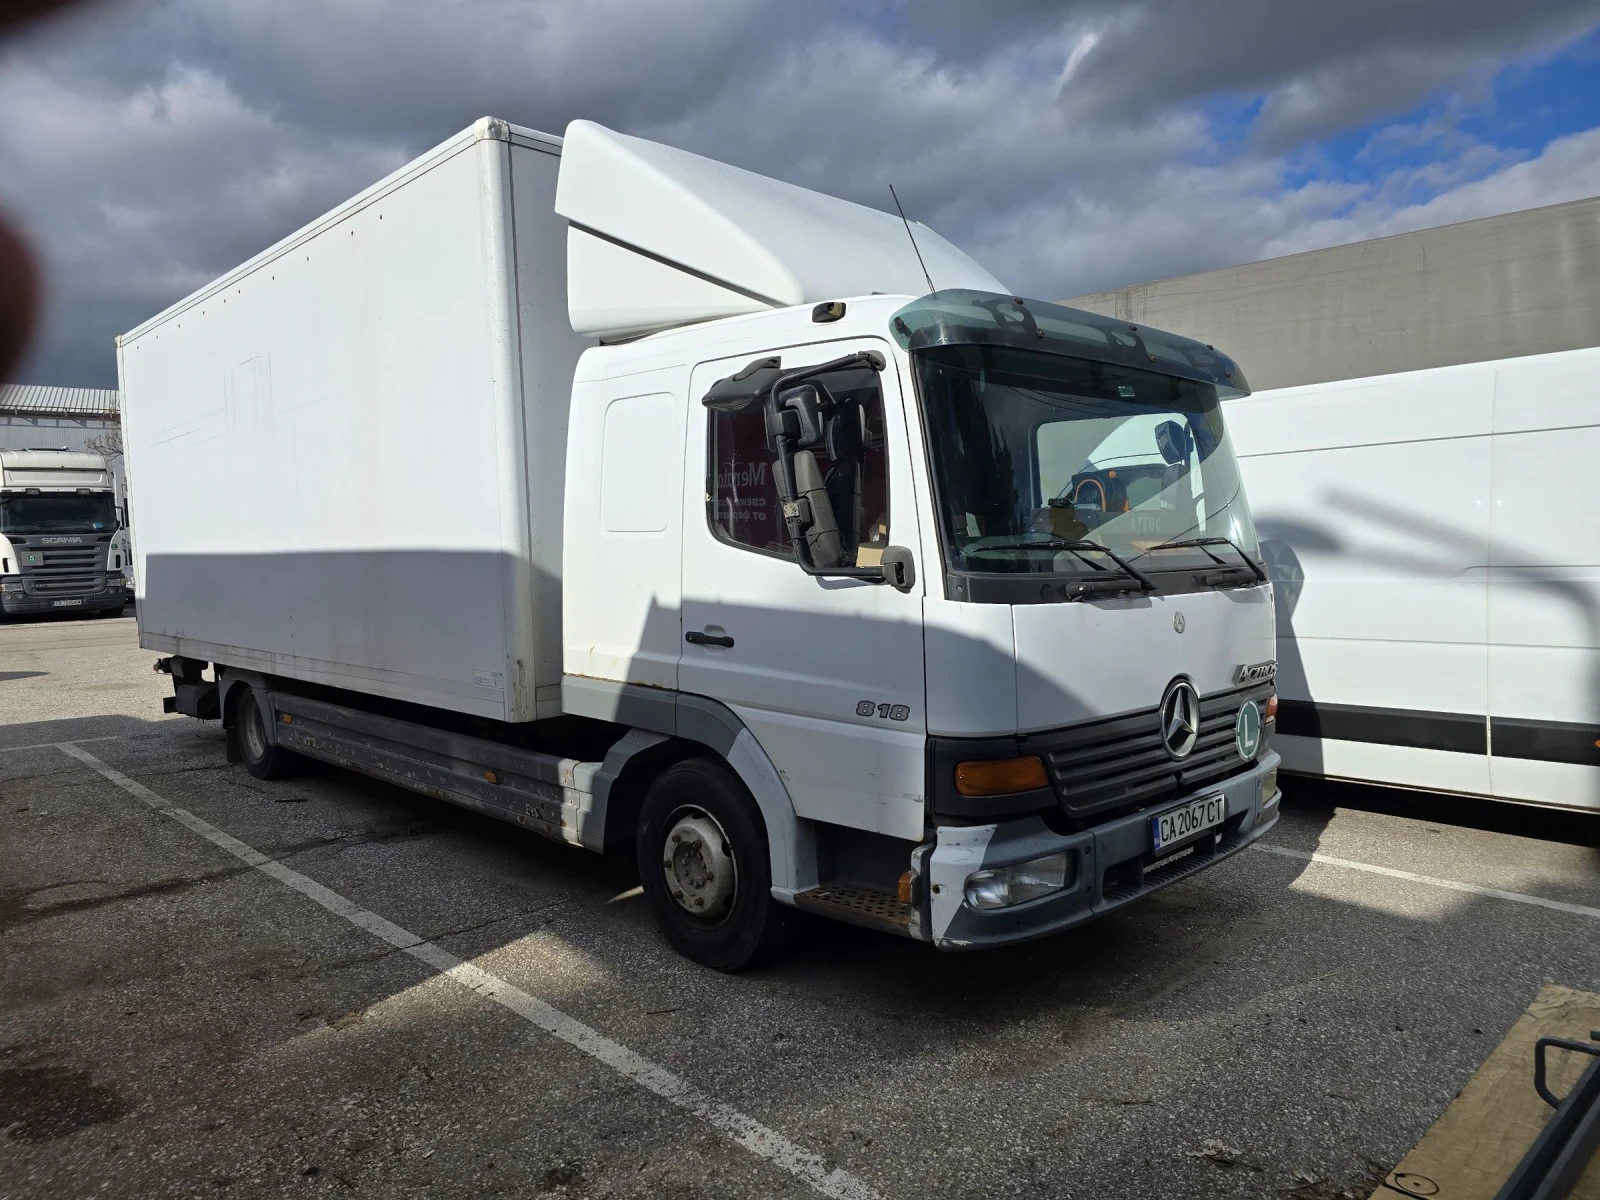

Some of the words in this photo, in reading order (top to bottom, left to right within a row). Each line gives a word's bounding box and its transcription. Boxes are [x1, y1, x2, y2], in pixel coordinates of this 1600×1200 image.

[41, 536, 83, 544] SCANIA
[856, 700, 910, 721] 818
[1244, 713, 1254, 748] L
